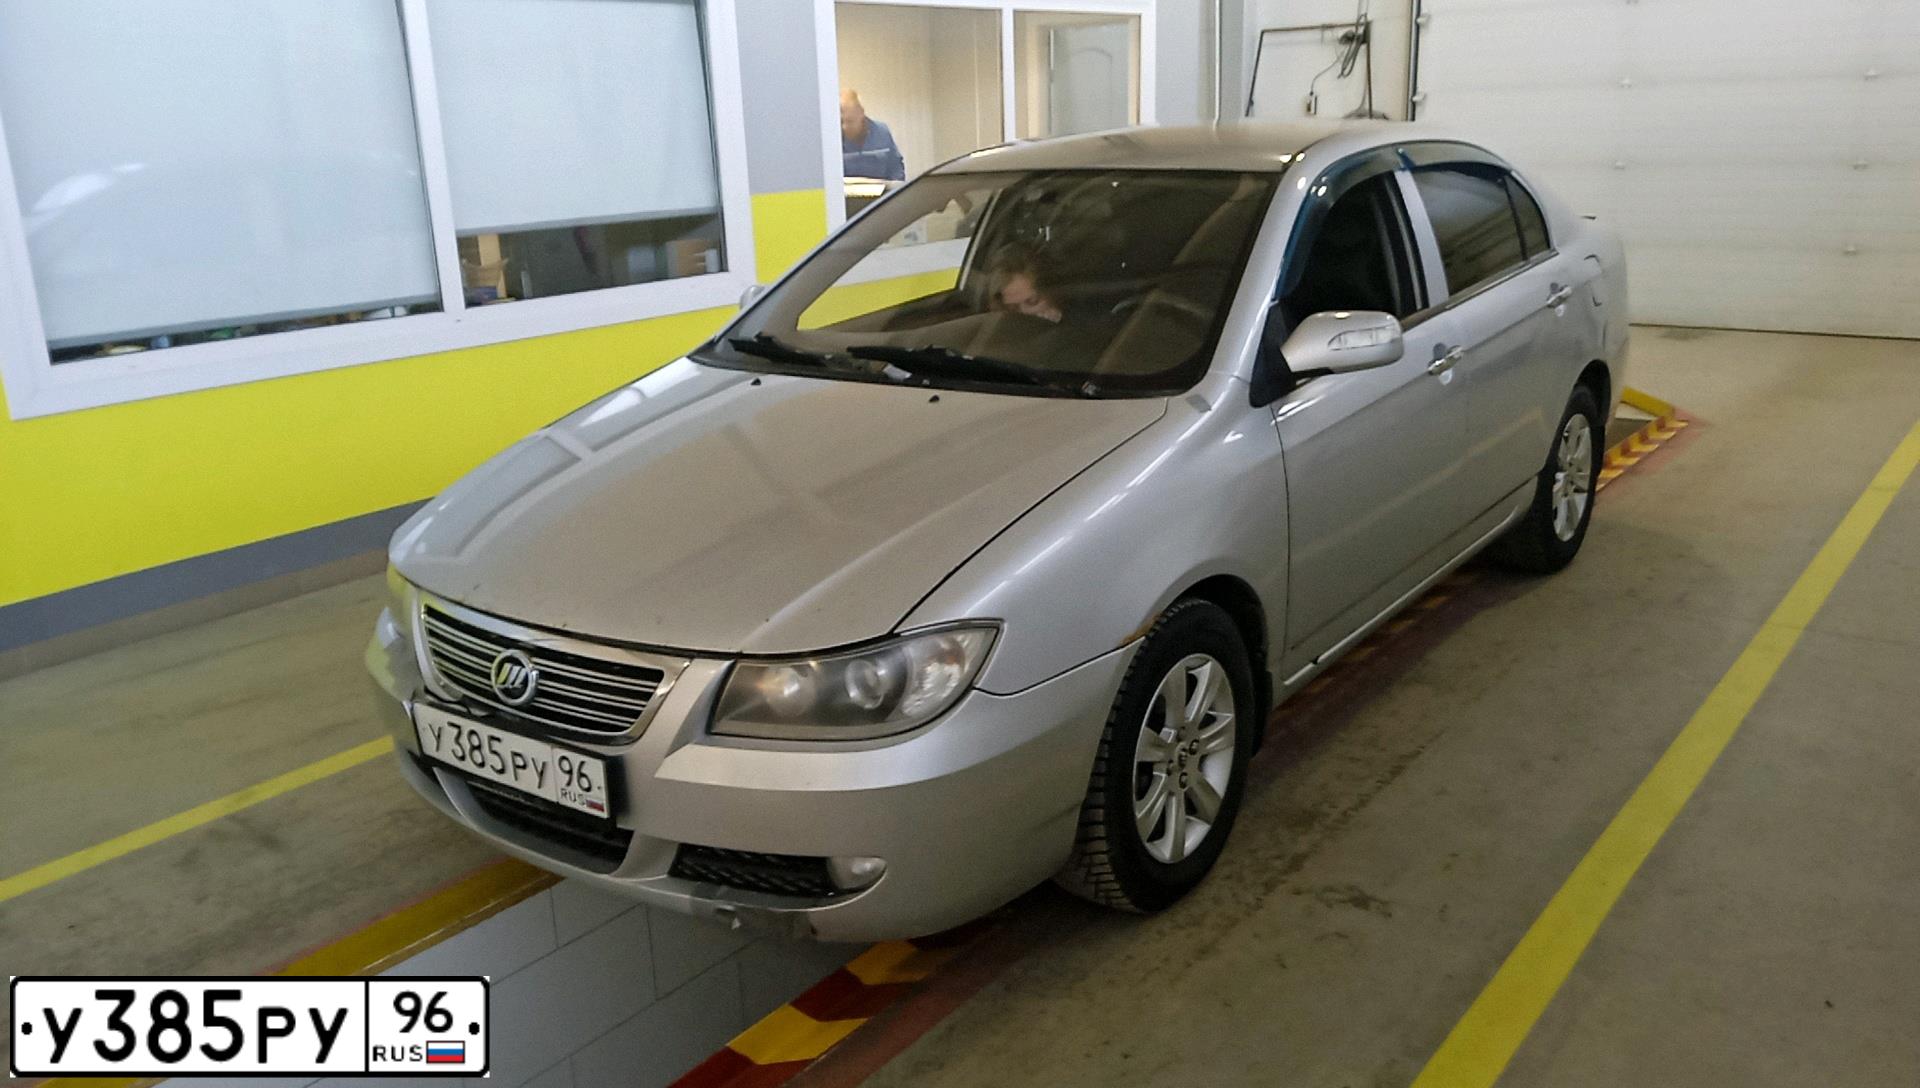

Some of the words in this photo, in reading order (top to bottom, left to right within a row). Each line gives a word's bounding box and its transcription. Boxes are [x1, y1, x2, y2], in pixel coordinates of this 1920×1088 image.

[428, 721, 546, 789] У385РУ
[558, 755, 592, 792] 96
[560, 788, 586, 806] RUS
